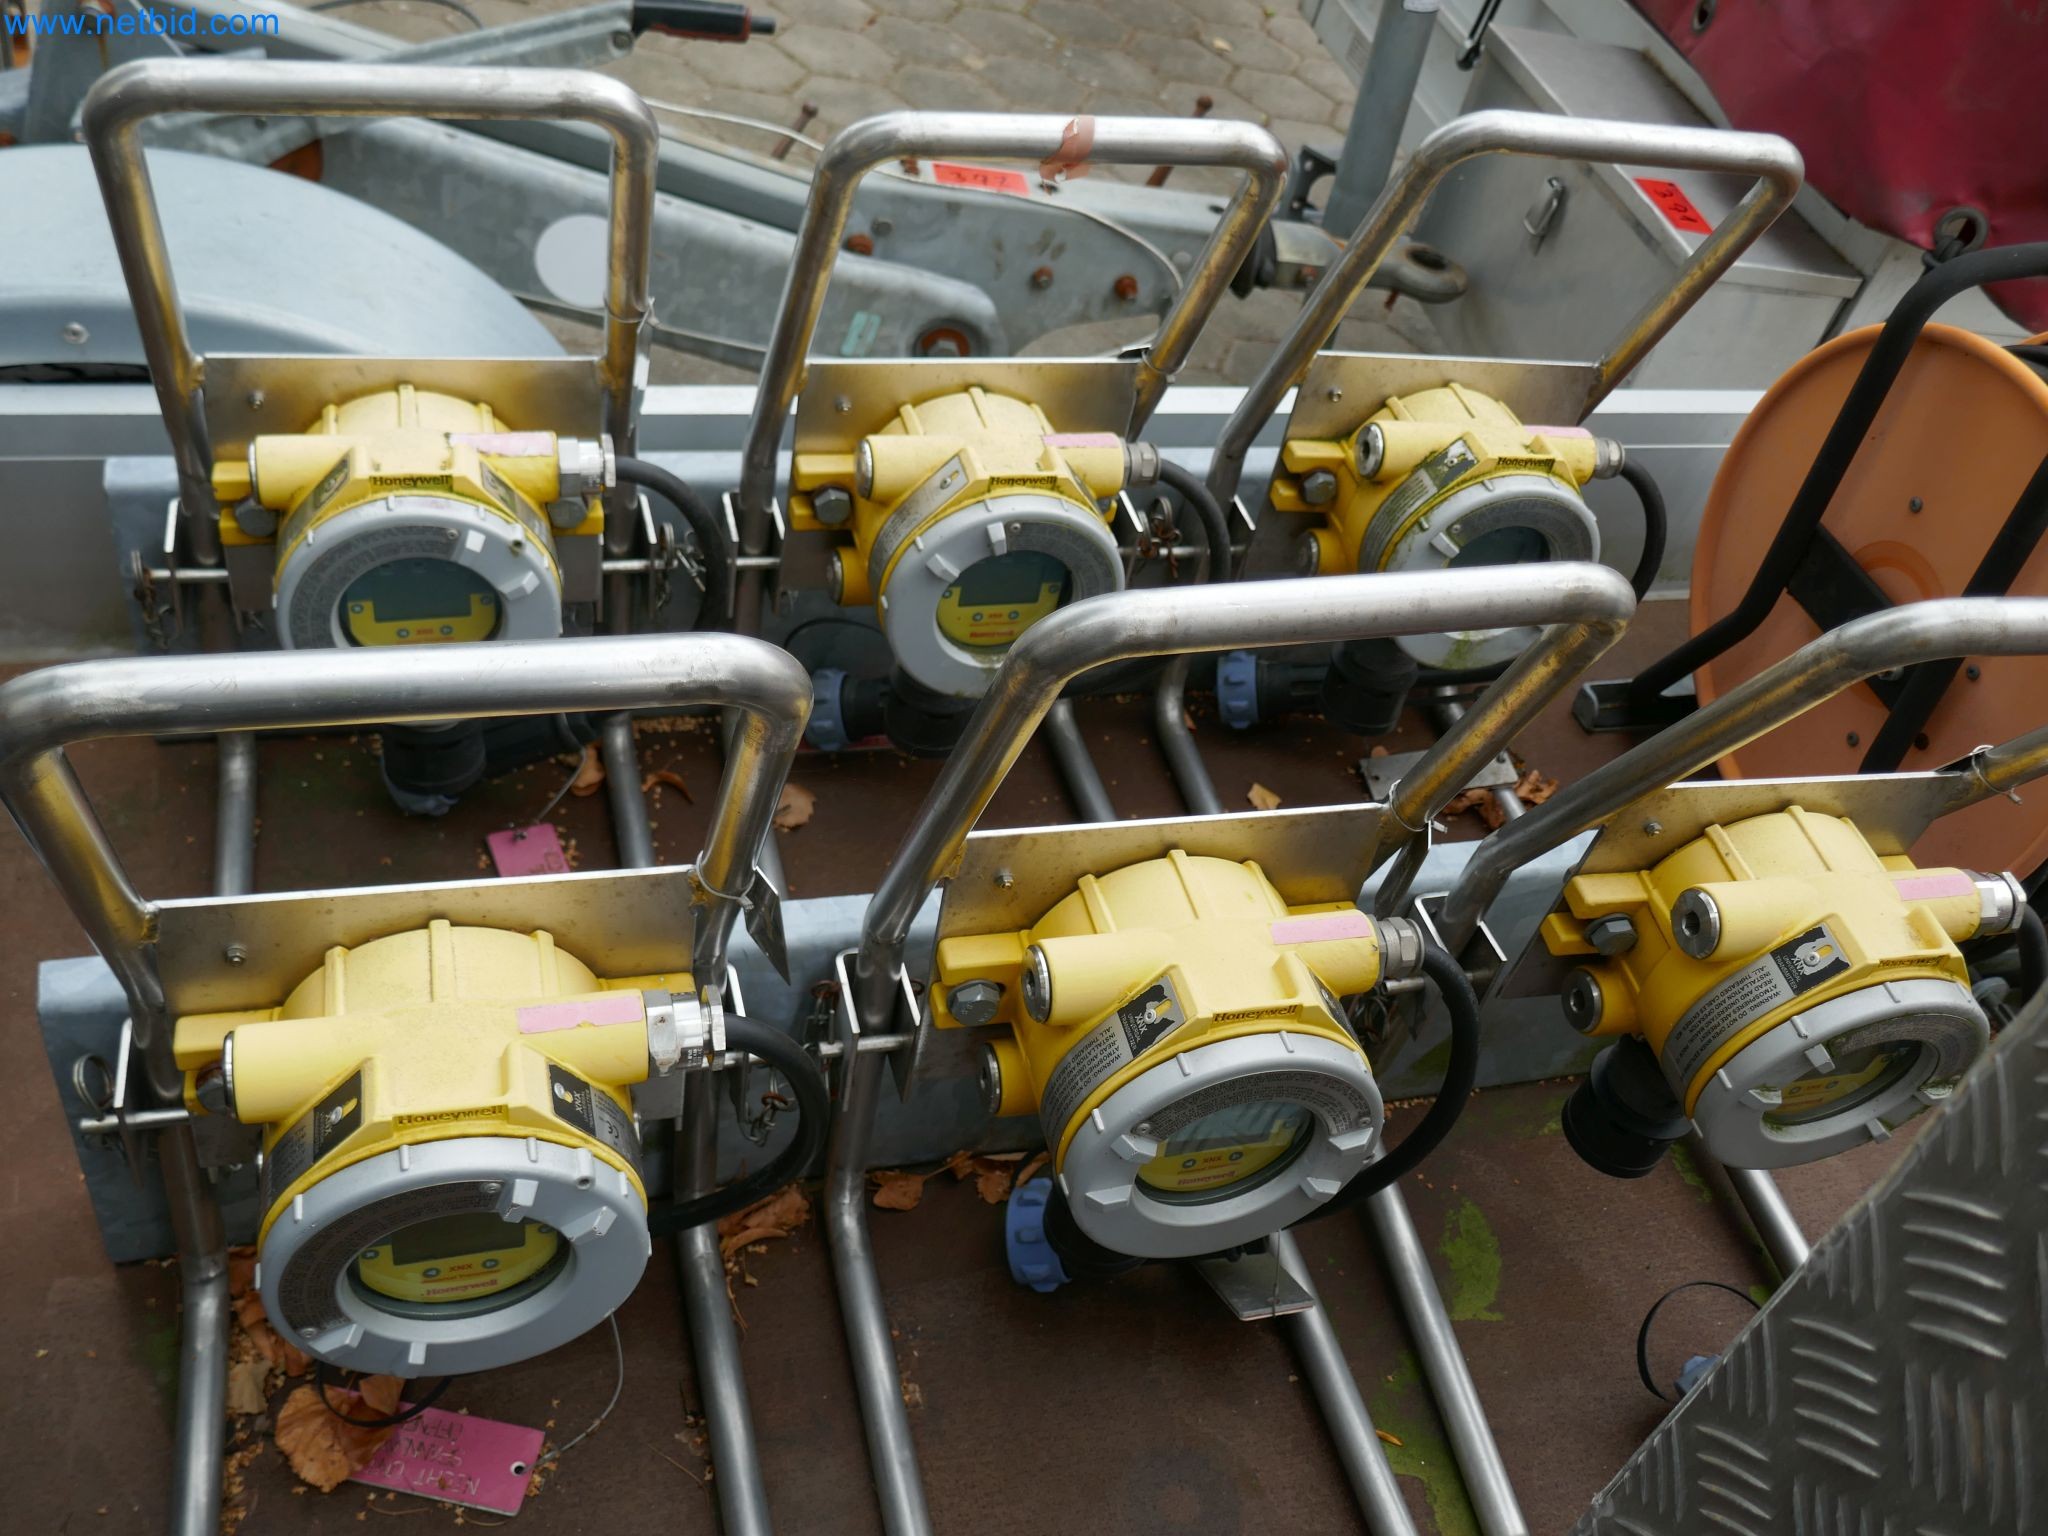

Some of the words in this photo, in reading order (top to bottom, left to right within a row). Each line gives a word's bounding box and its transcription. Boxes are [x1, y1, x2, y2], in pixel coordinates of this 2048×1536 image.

[1497, 456, 1555, 468] Honeywell
[372, 474, 450, 487] Honeywell
[991, 475, 1058, 488] Honeywell
[1790, 955, 1807, 975] XNX
[1718, 973, 1752, 997] THREADED
[1726, 970, 1771, 1000] INSTALLATION
[1731, 983, 1778, 1014] ATMOSPHERES
[1739, 988, 1754, 1001] AND
[1713, 998, 1727, 1010] AND
[1214, 1004, 1297, 1021] Honeywell
[1719, 1011, 1732, 1023] ARE
[1736, 1009, 1748, 1019] DO
[1134, 1012, 1148, 1034] XNX
[1724, 1016, 1738, 1028] NOT
[1074, 1031, 1116, 1066] INSTALLATION
[1085, 1053, 1099, 1066] AND
[1082, 1076, 1093, 1087] DO
[398, 1104, 503, 1124] Honeywell
[449, 1263, 473, 1273] XNX
[426, 1278, 498, 1296] Honeywell
